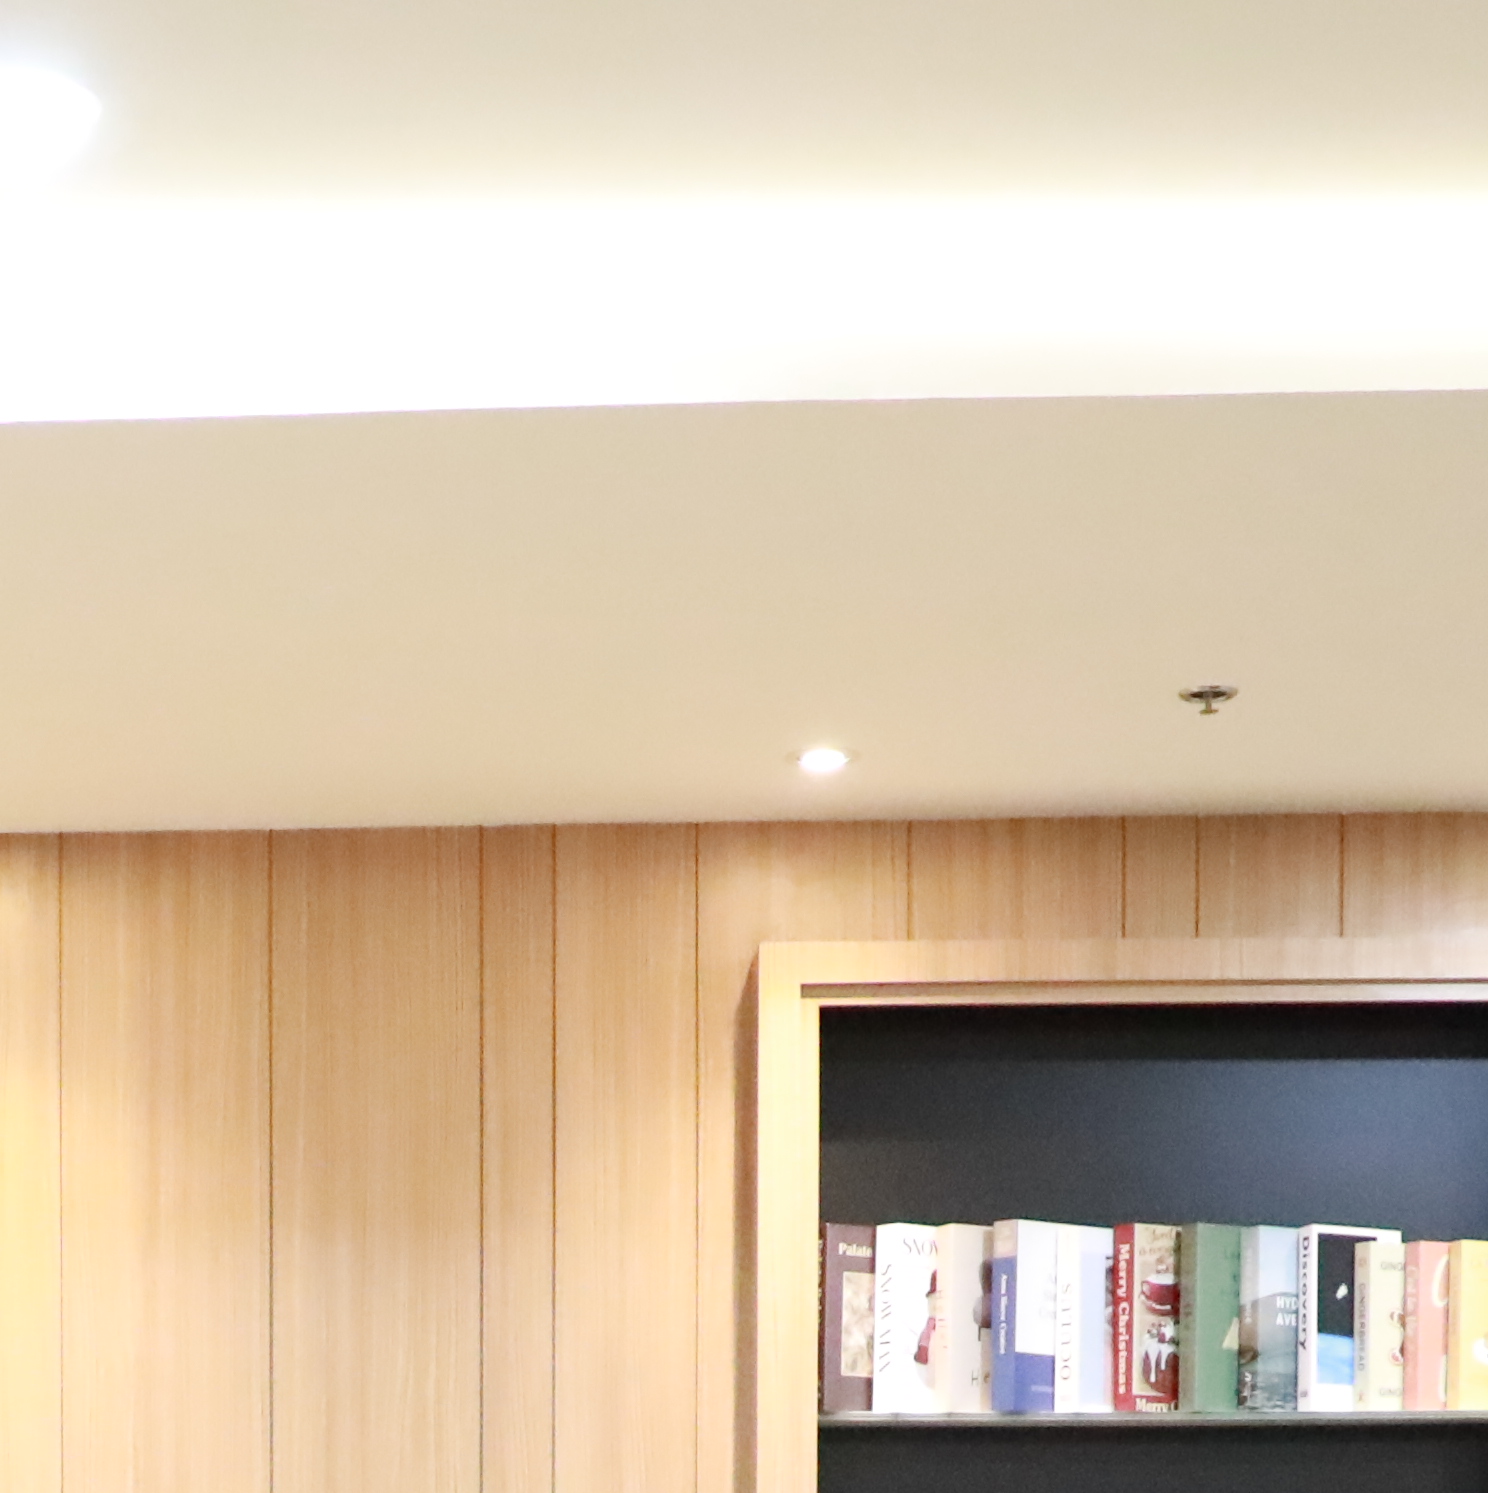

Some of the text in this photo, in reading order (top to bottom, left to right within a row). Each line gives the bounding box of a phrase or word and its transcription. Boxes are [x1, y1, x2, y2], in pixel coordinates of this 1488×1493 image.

[1116, 1244, 1130, 1395] Merry Christmas
[1298, 1236, 1310, 1350] Discovery
